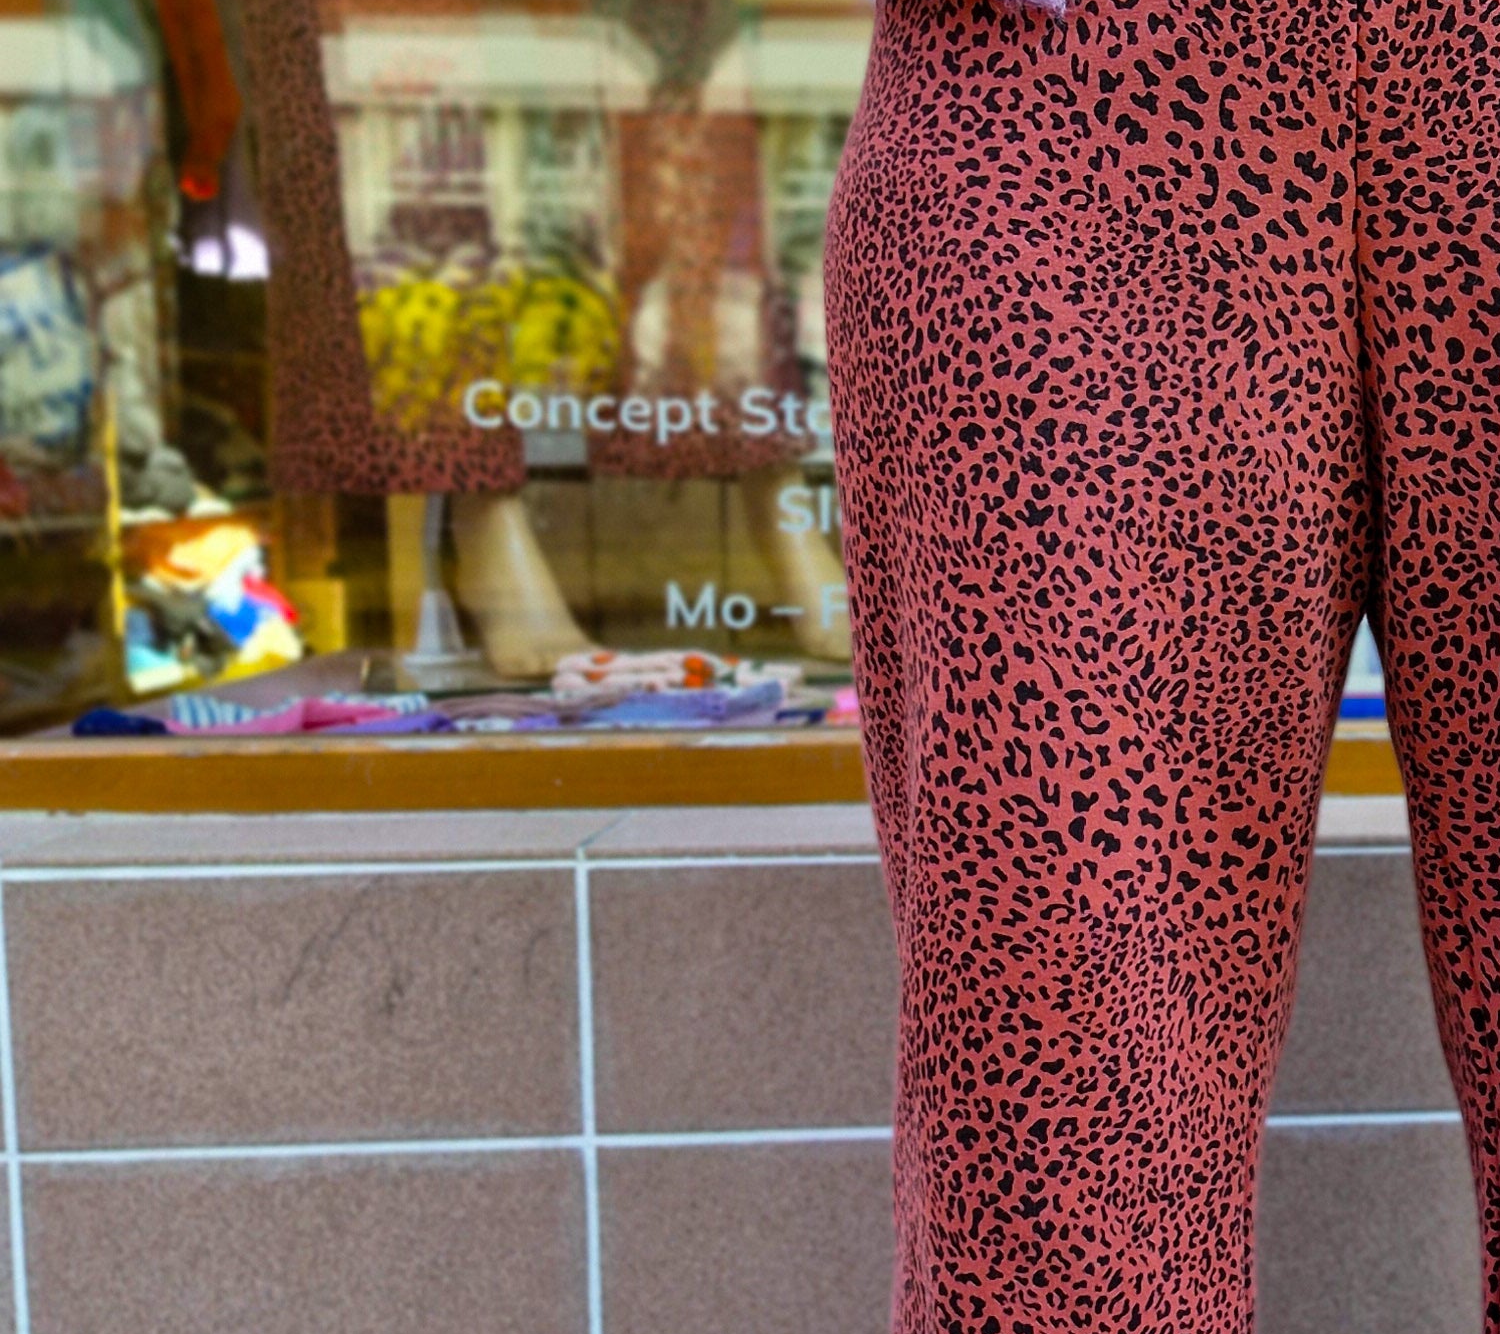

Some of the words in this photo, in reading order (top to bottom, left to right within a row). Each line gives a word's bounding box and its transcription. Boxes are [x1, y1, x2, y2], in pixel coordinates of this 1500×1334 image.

[462, 380, 718, 445] Concept
[777, 484, 843, 535] Sl
[665, 581, 757, 630] Mo
